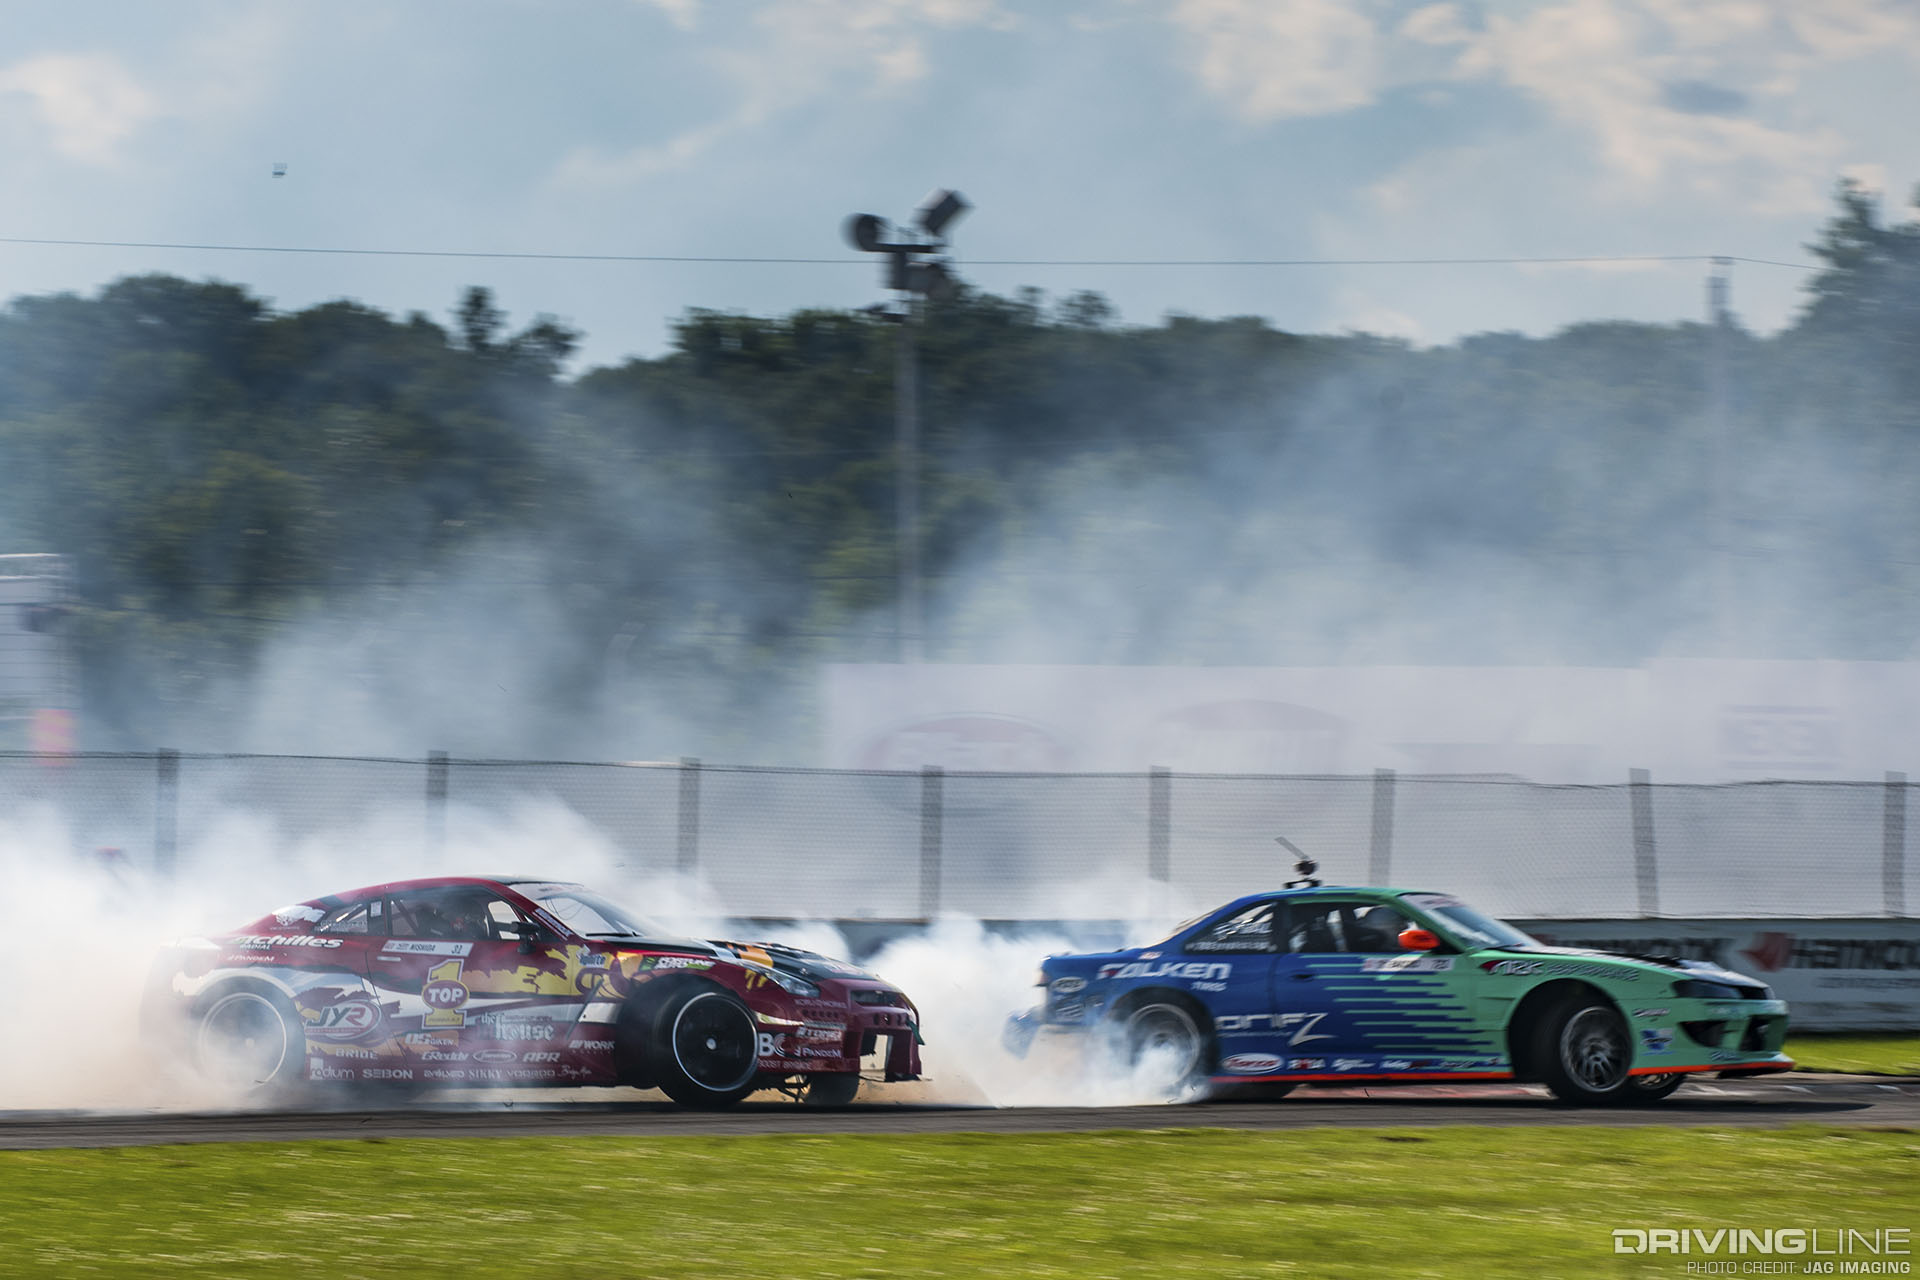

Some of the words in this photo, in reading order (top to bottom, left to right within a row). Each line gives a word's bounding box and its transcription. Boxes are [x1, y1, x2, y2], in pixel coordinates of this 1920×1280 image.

[1096, 962, 1232, 980] FALKEN
[428, 987, 464, 1003] TOP
[584, 1040, 615, 1049] WORK
